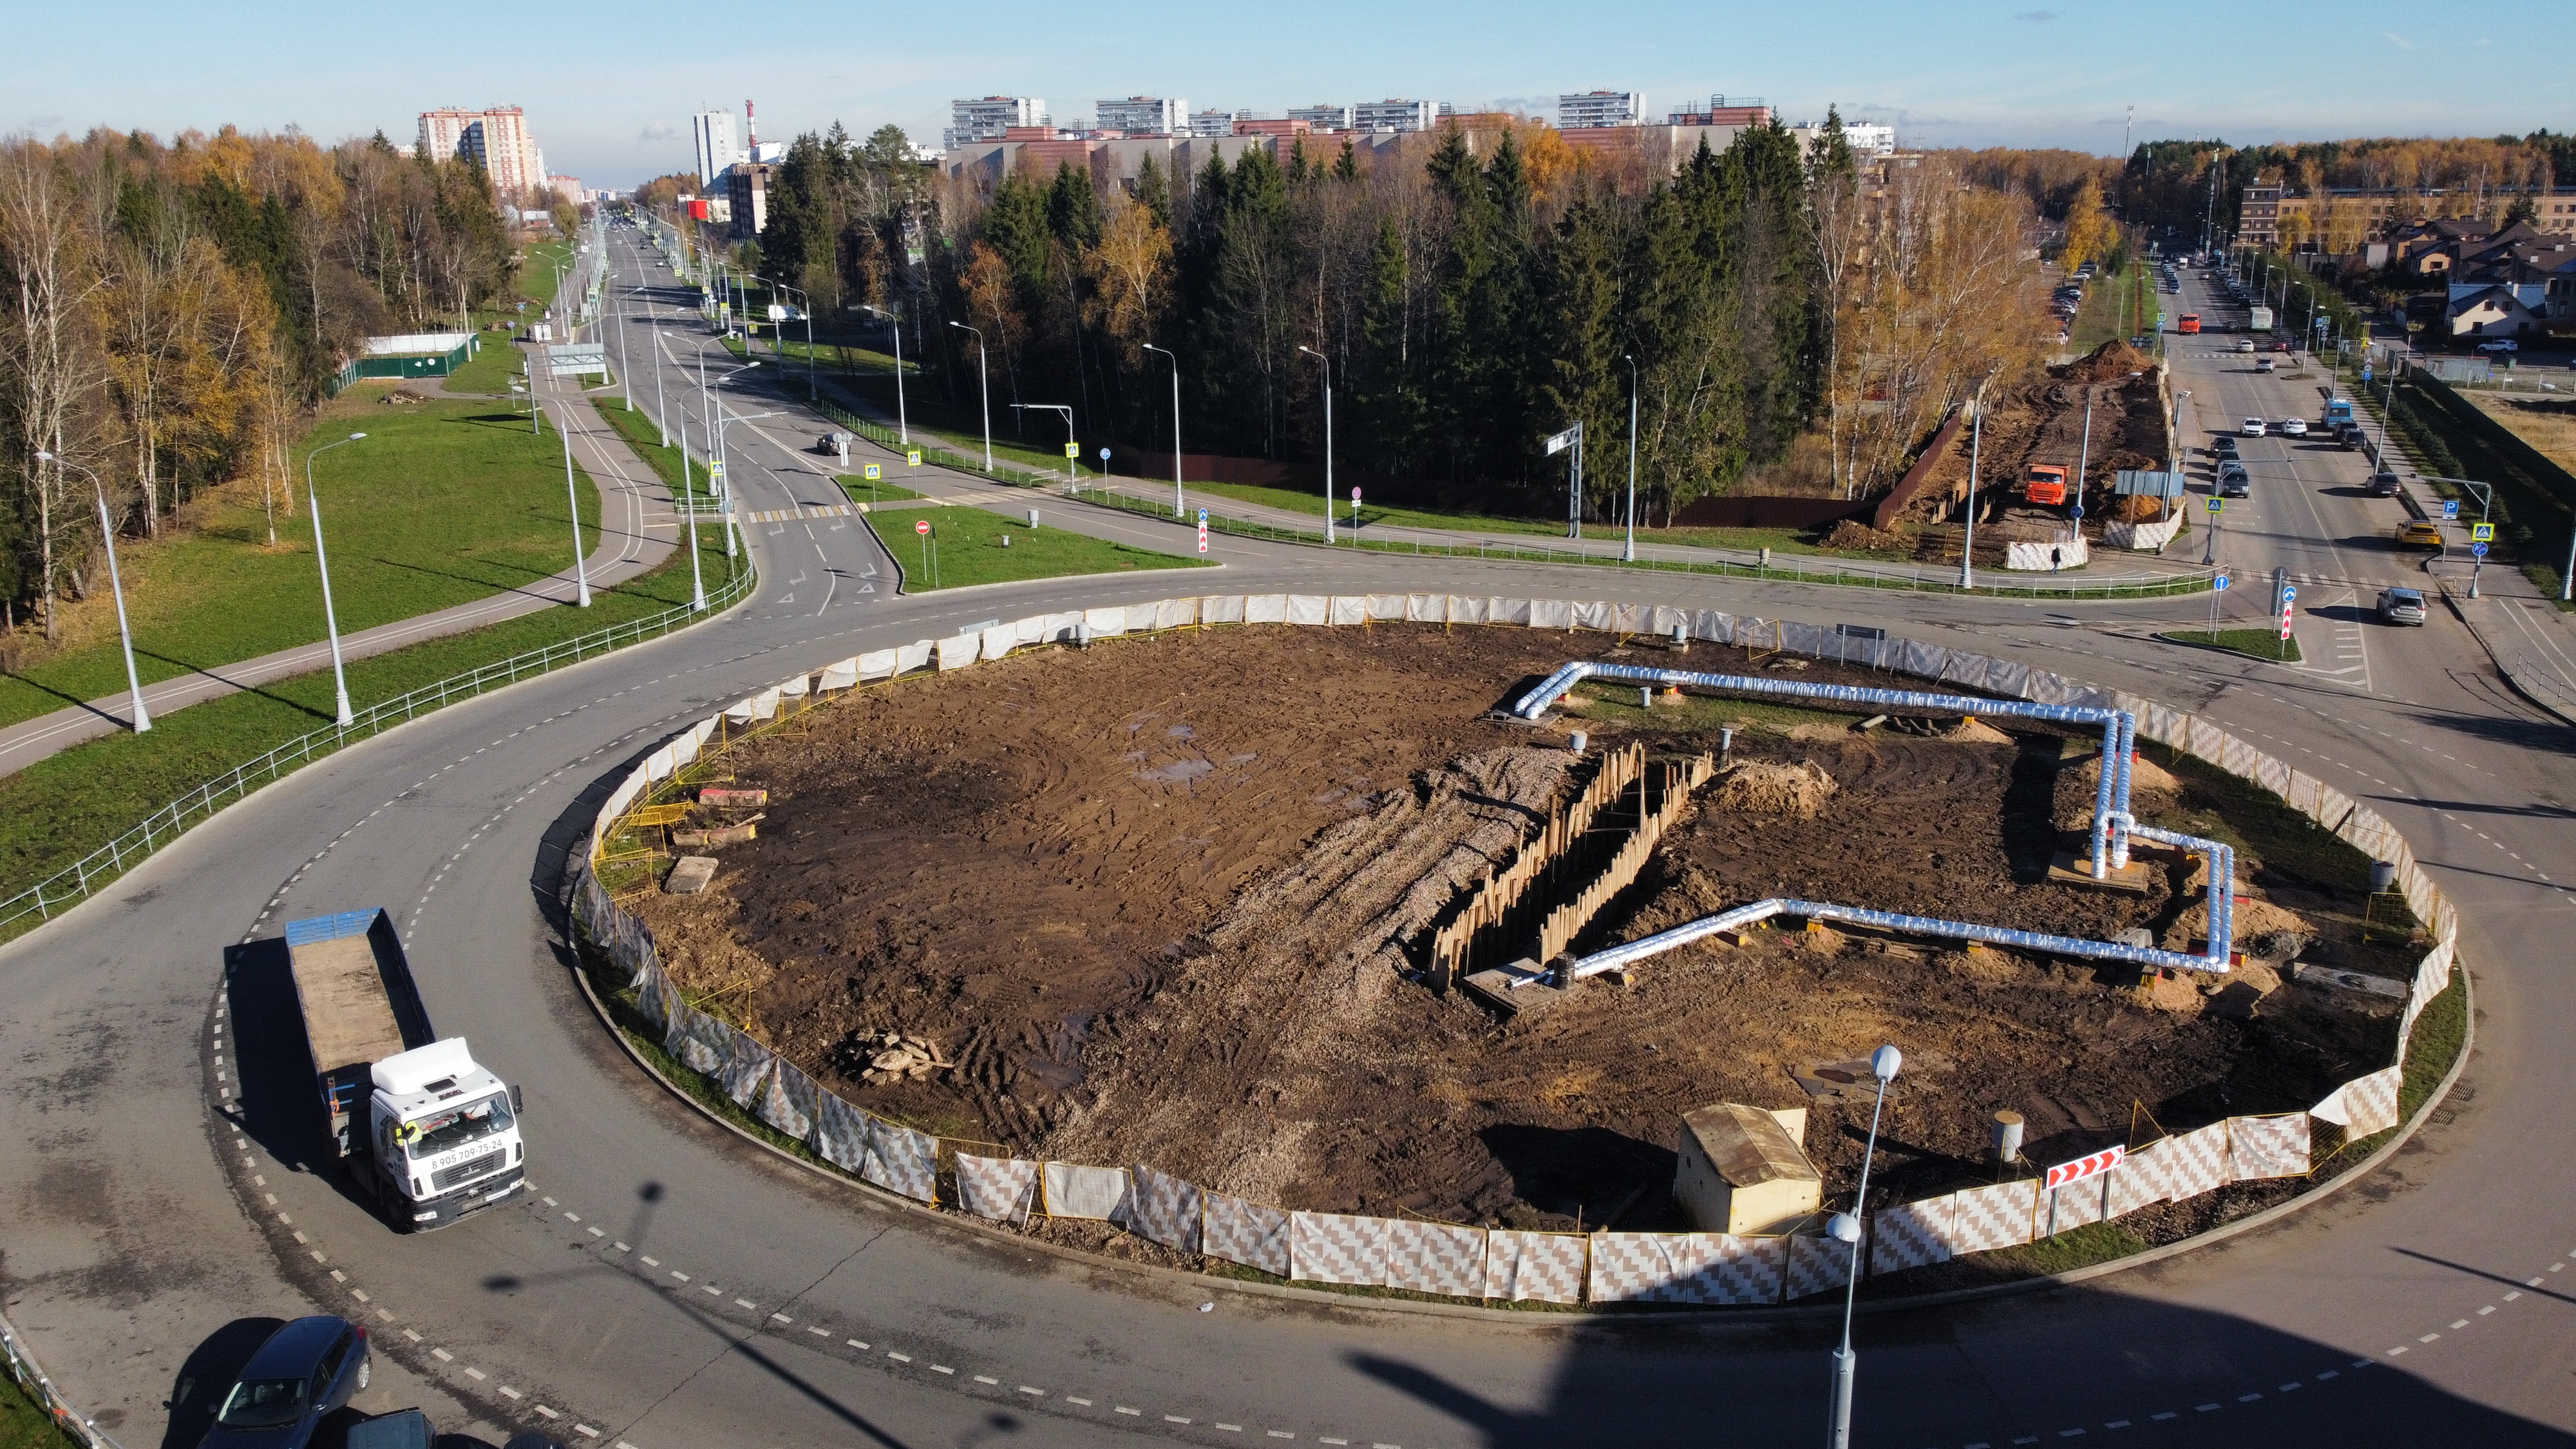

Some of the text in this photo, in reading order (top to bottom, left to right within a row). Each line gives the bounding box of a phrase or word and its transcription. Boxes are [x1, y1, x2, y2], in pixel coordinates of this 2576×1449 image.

[2446, 502, 2456, 512] P
[432, 1139, 502, 1170] 8 905 709-75-24
